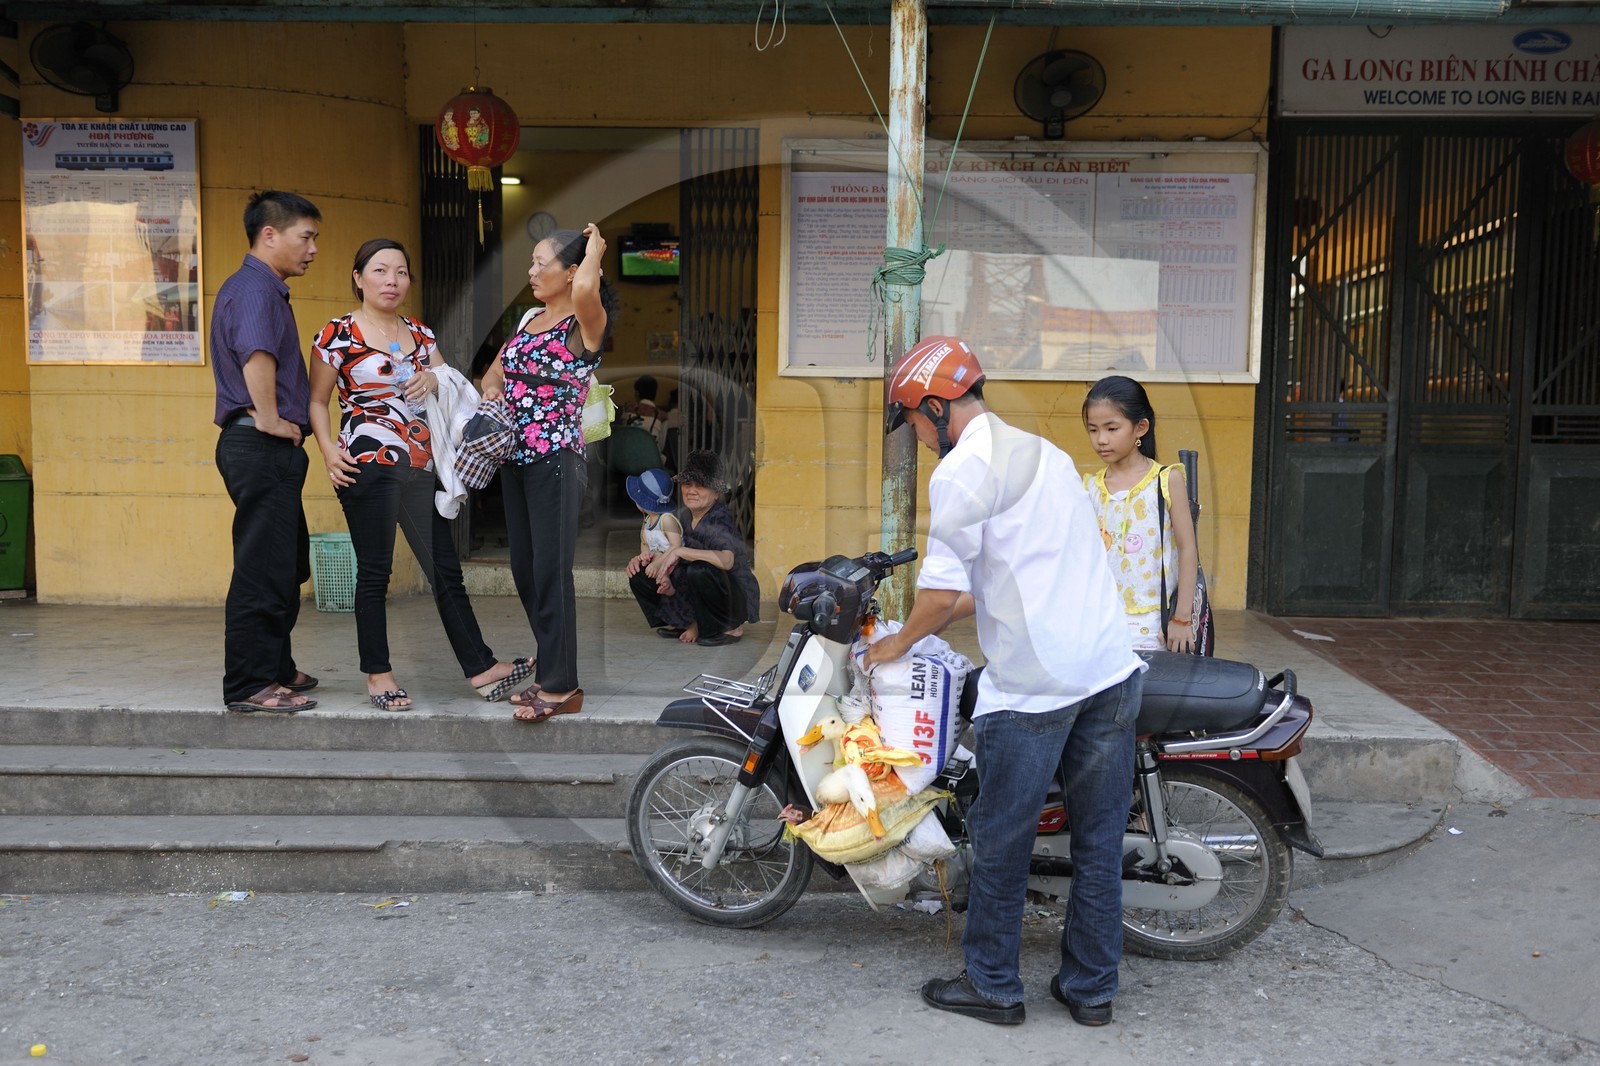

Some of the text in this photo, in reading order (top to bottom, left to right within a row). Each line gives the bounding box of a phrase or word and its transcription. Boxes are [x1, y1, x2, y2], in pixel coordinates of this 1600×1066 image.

[1302, 58, 1336, 81] GA
[1343, 58, 1413, 82] LONG
[1419, 53, 1477, 82] BIÊN
[1484, 52, 1547, 82] KÍNH
[1363, 90, 1446, 105] WELCOME
[1451, 90, 1473, 105] TO
[1477, 90, 1526, 105] LONG
[1531, 90, 1566, 105] BIEN
[78, 122, 88, 131] XE
[90, 121, 117, 131] KHÁCH
[170, 123, 187, 132] CAO
[88, 132, 110, 140] HOA
[971, 158, 1035, 173] KHÁCH
[1087, 157, 1130, 173] BIẾT
[831, 183, 887, 193] THÔNG BÁ
[1047, 176, 1060, 185] ĐI
[915, 345, 953, 386] YAMAHA
[911, 662, 926, 700] LEAN
